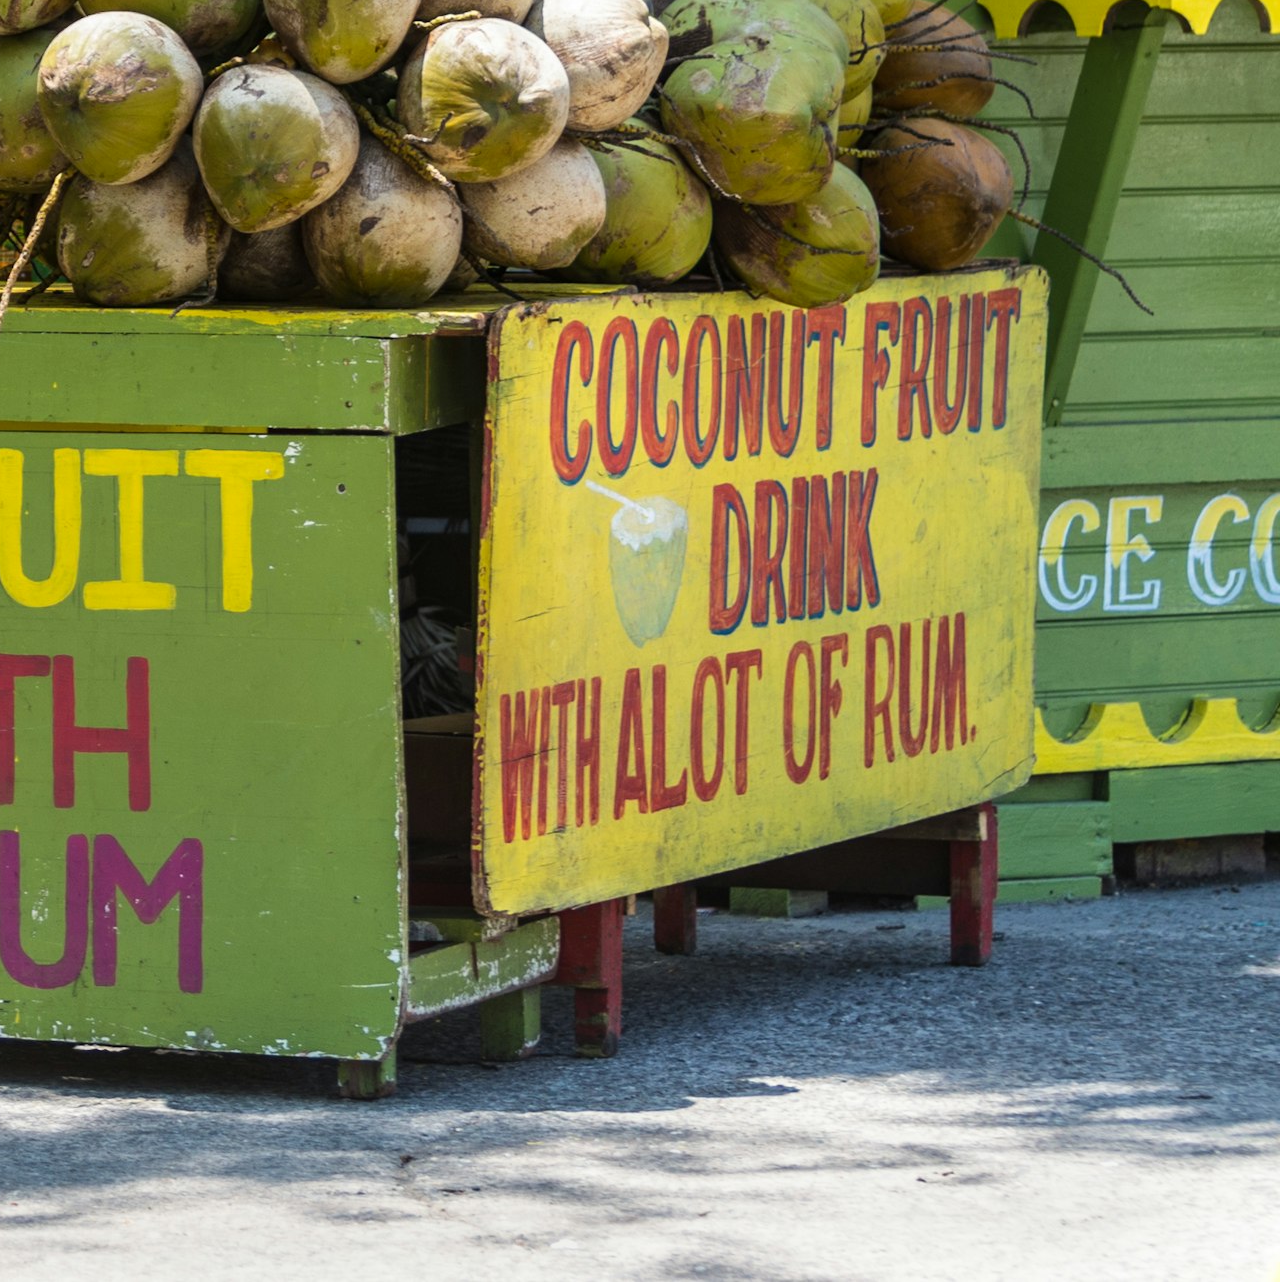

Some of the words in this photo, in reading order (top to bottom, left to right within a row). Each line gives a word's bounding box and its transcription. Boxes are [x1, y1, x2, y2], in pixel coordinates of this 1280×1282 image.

[549, 306, 845, 485] COCONUT
[860, 288, 1022, 448] FRUIT
[709, 467, 881, 636] DRINK
[1038, 494, 1164, 612] CE
[499, 676, 602, 844] WITH
[783, 632, 849, 785] OF
[863, 611, 977, 769] RUM.
